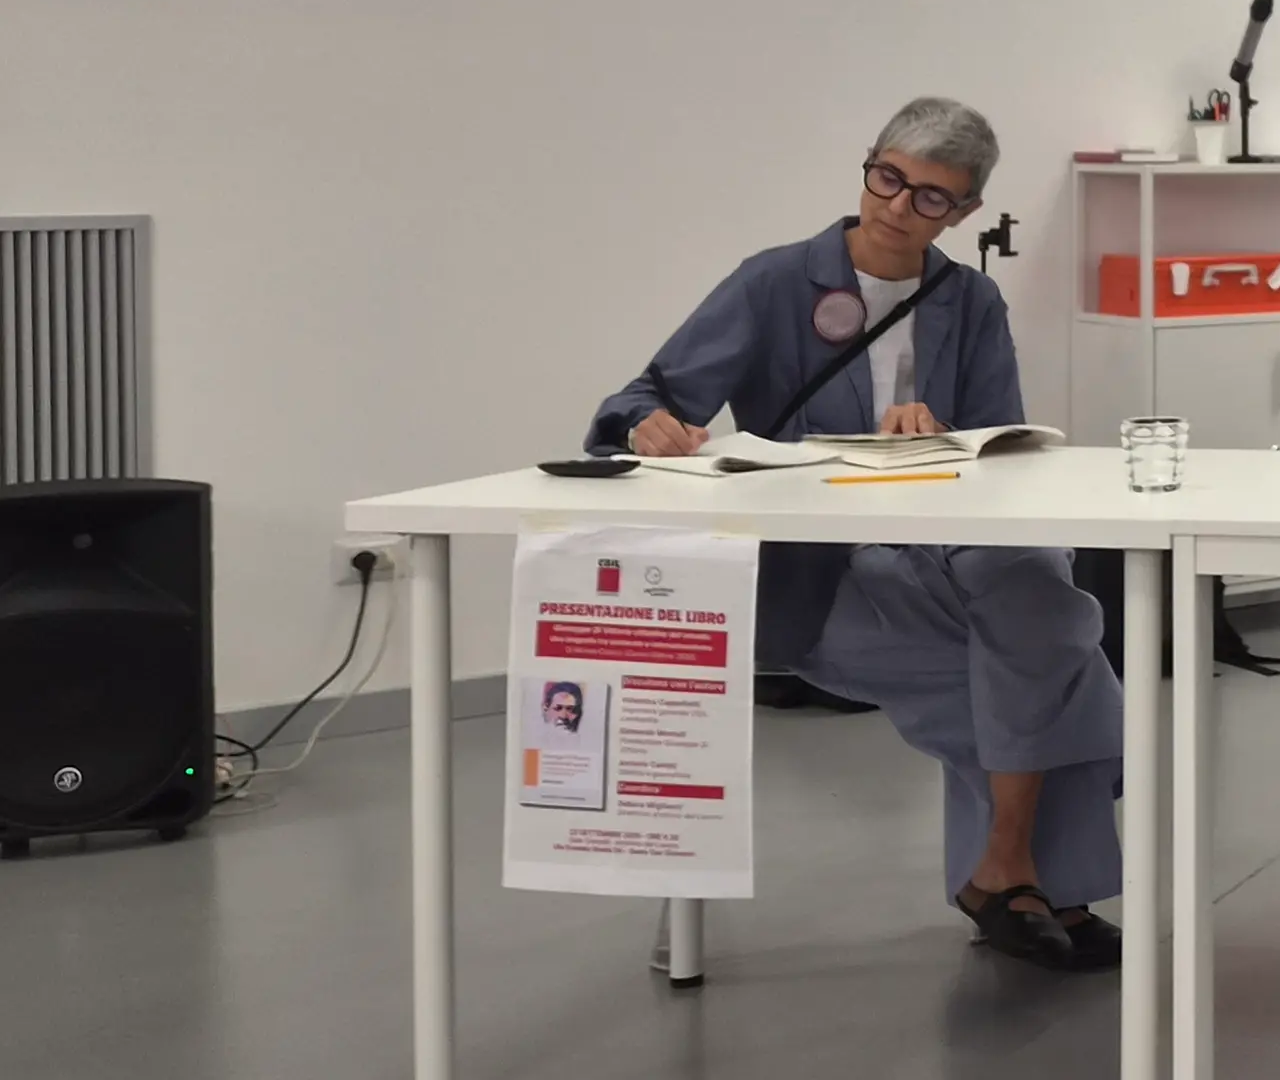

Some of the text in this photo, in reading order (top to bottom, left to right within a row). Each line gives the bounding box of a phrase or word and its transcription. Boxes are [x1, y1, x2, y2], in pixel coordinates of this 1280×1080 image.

[540, 602, 726, 625] PRESENTAZIONE DEL LIBRO
